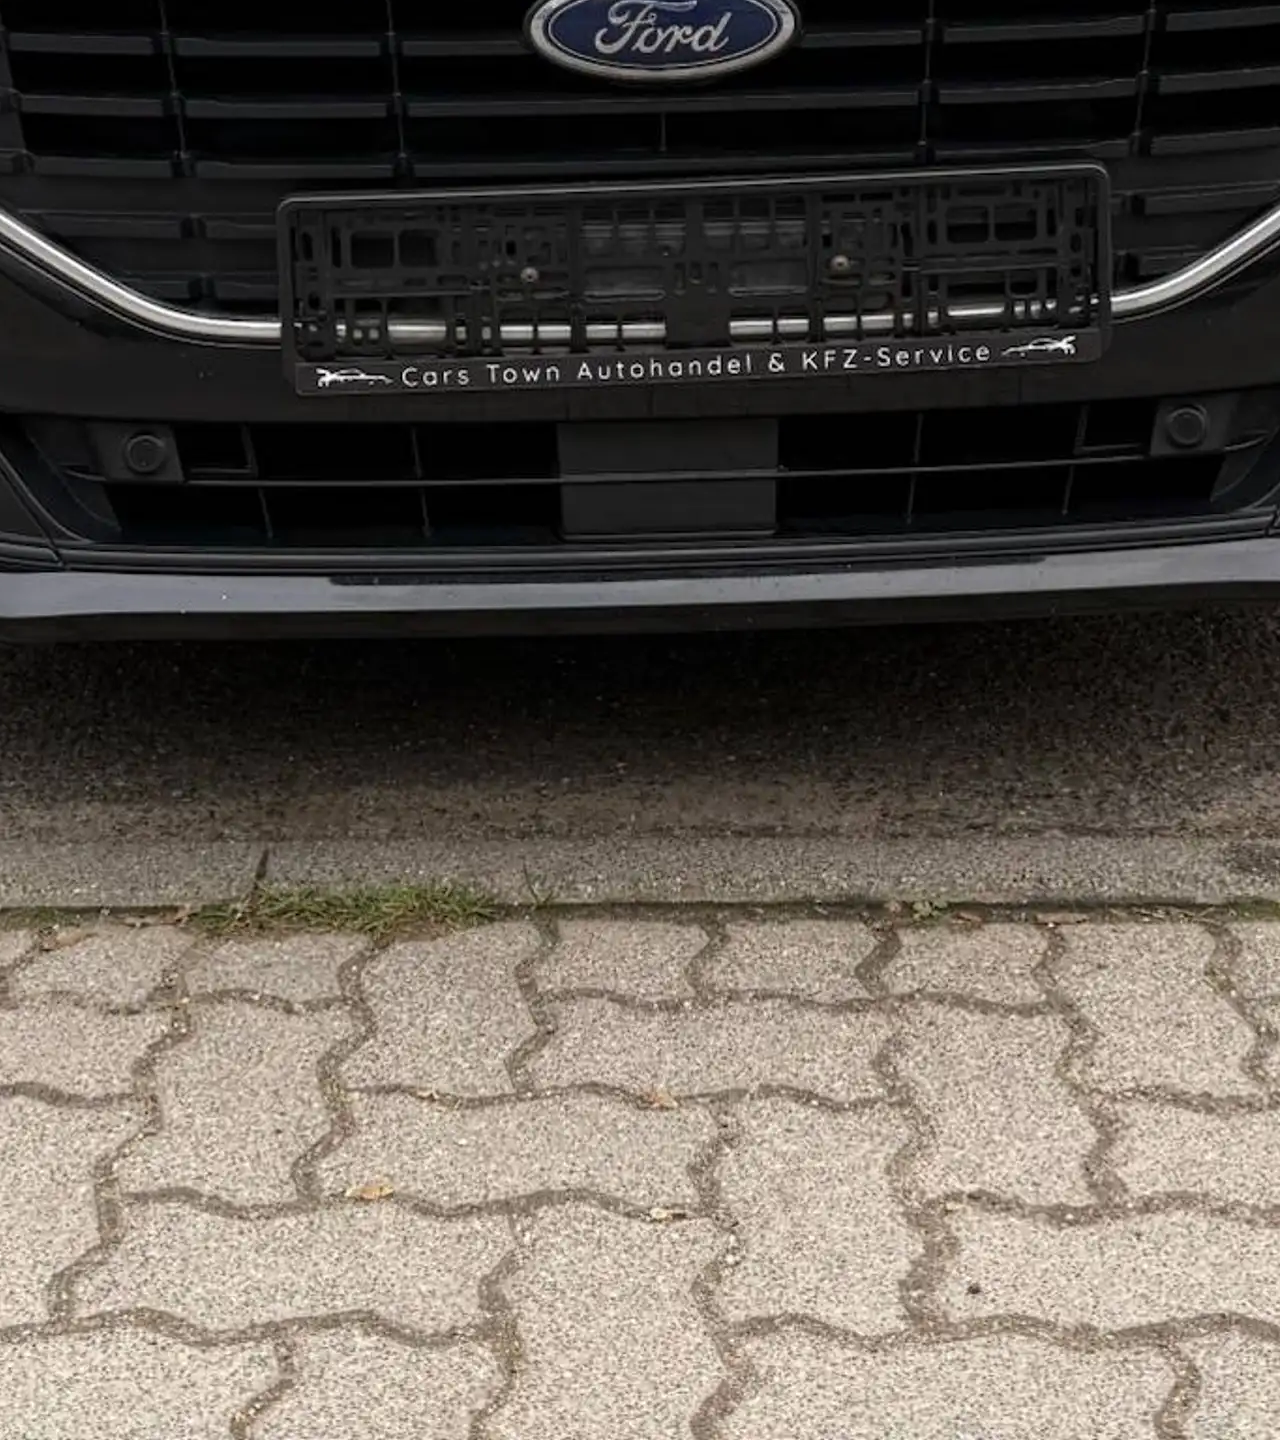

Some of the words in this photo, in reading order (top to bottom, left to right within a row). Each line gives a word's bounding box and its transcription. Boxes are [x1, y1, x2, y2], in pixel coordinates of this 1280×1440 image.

[401, 366, 470, 388] Cars
[485, 363, 561, 384] Town
[576, 355, 752, 381] Autohandel
[769, 352, 785, 373] &
[801, 344, 991, 372] KFZ-Service
